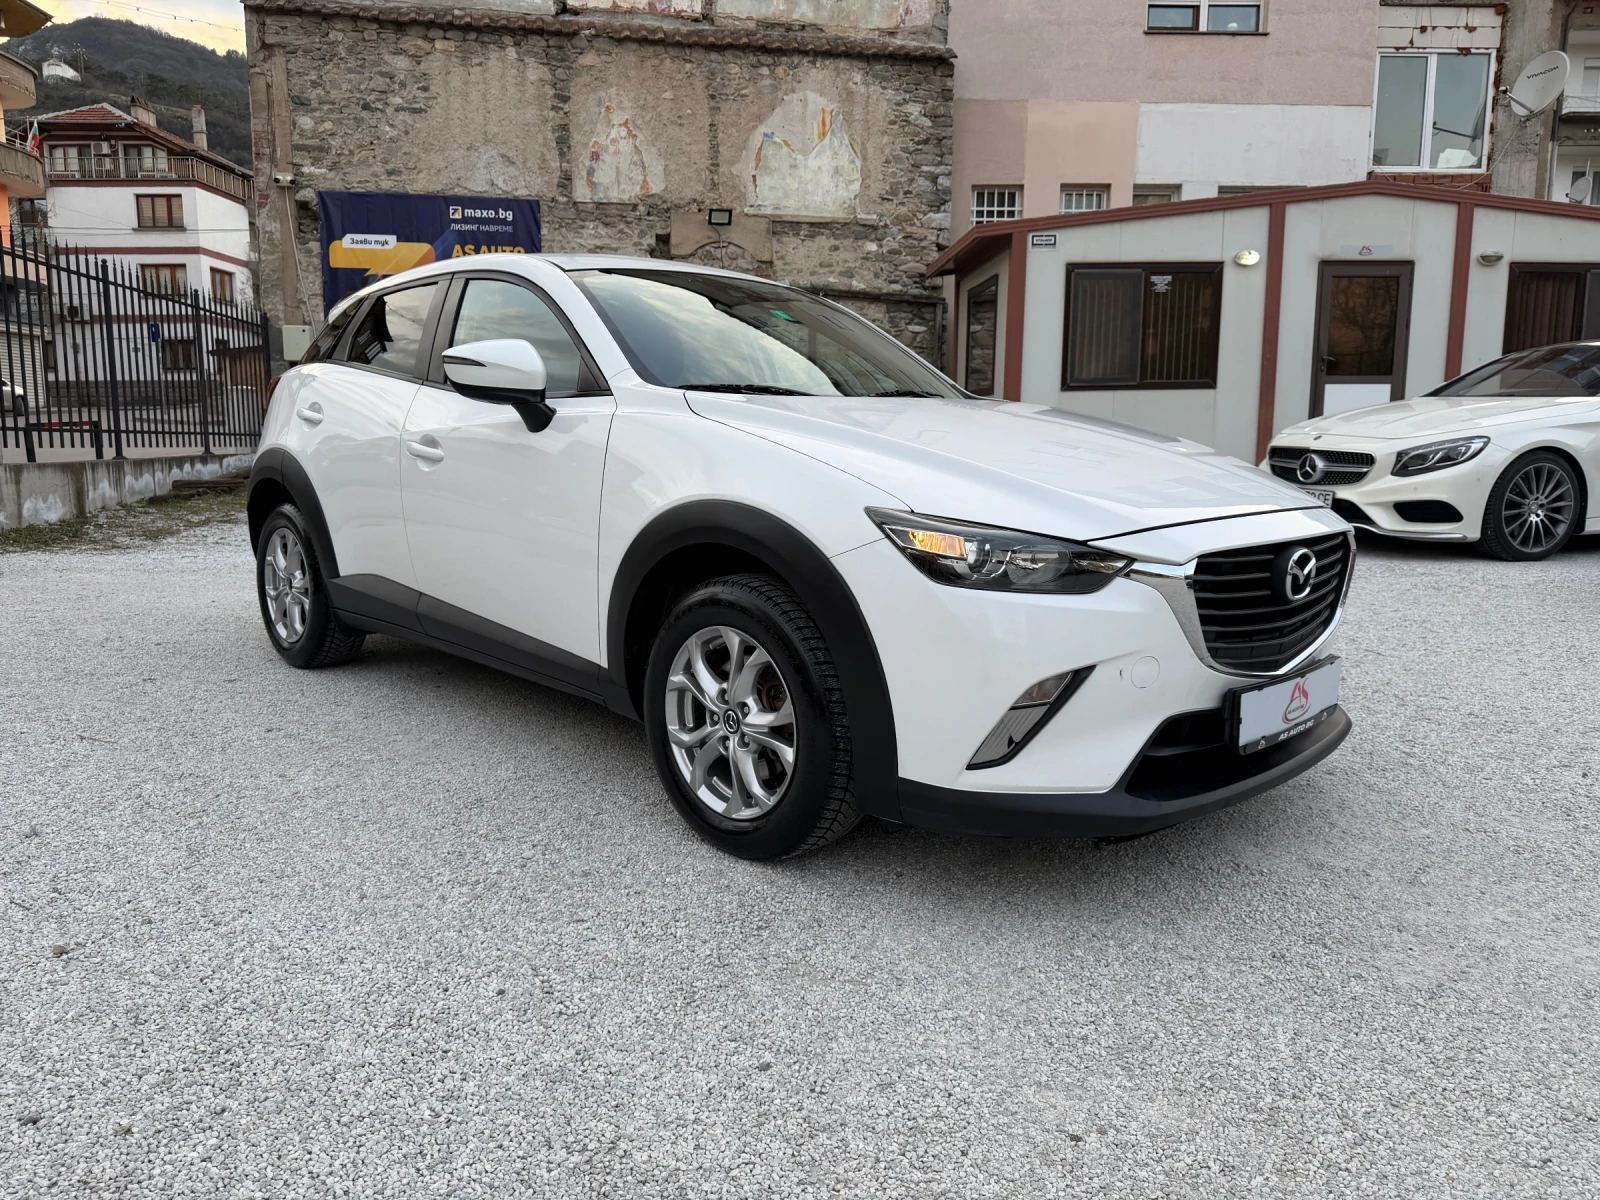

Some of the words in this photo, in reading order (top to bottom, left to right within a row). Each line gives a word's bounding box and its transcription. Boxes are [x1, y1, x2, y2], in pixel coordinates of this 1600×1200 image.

[1527, 66, 1559, 79] VIVACOM
[464, 207, 513, 221] maxo.bg
[450, 223, 479, 231] ЛИЗИНГ
[480, 225, 514, 233] НАВРЕМЕ
[373, 239, 390, 247] тук
[451, 244, 476, 258] AS
[1278, 732, 1288, 740] AS
[1289, 724, 1305, 736] AUTO
